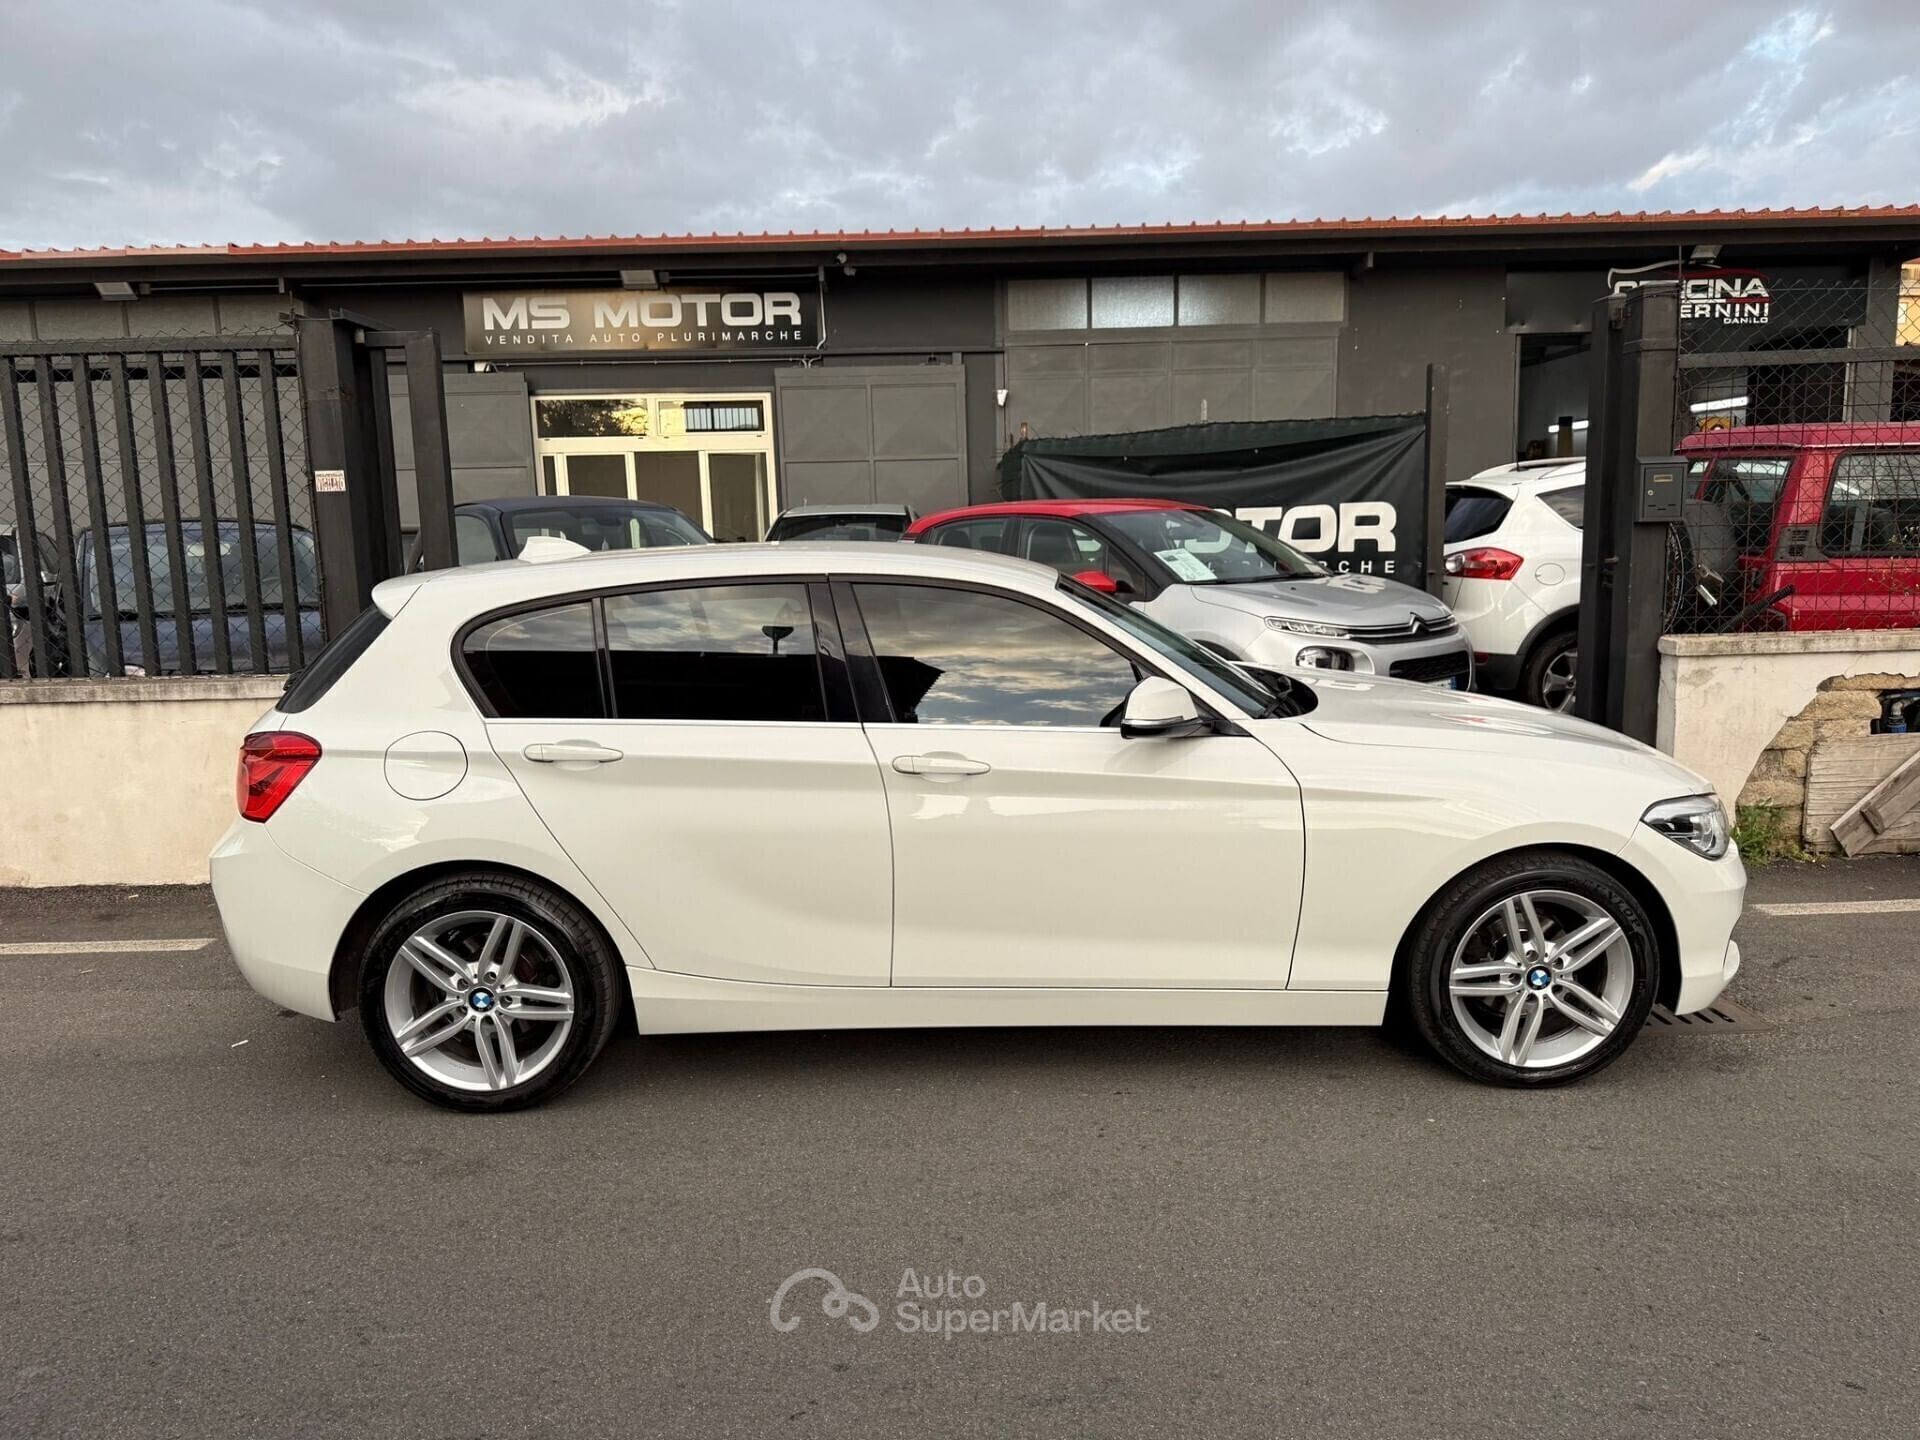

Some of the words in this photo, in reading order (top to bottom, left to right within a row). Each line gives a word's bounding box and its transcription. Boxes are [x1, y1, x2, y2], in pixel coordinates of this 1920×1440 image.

[483, 297, 570, 330] MS
[594, 292, 802, 328] MOTOR
[1680, 303, 1769, 318] ERNINI
[485, 334, 574, 345] VENDITA
[589, 332, 642, 344] AUTO
[657, 330, 802, 342] PLURIMARCHE
